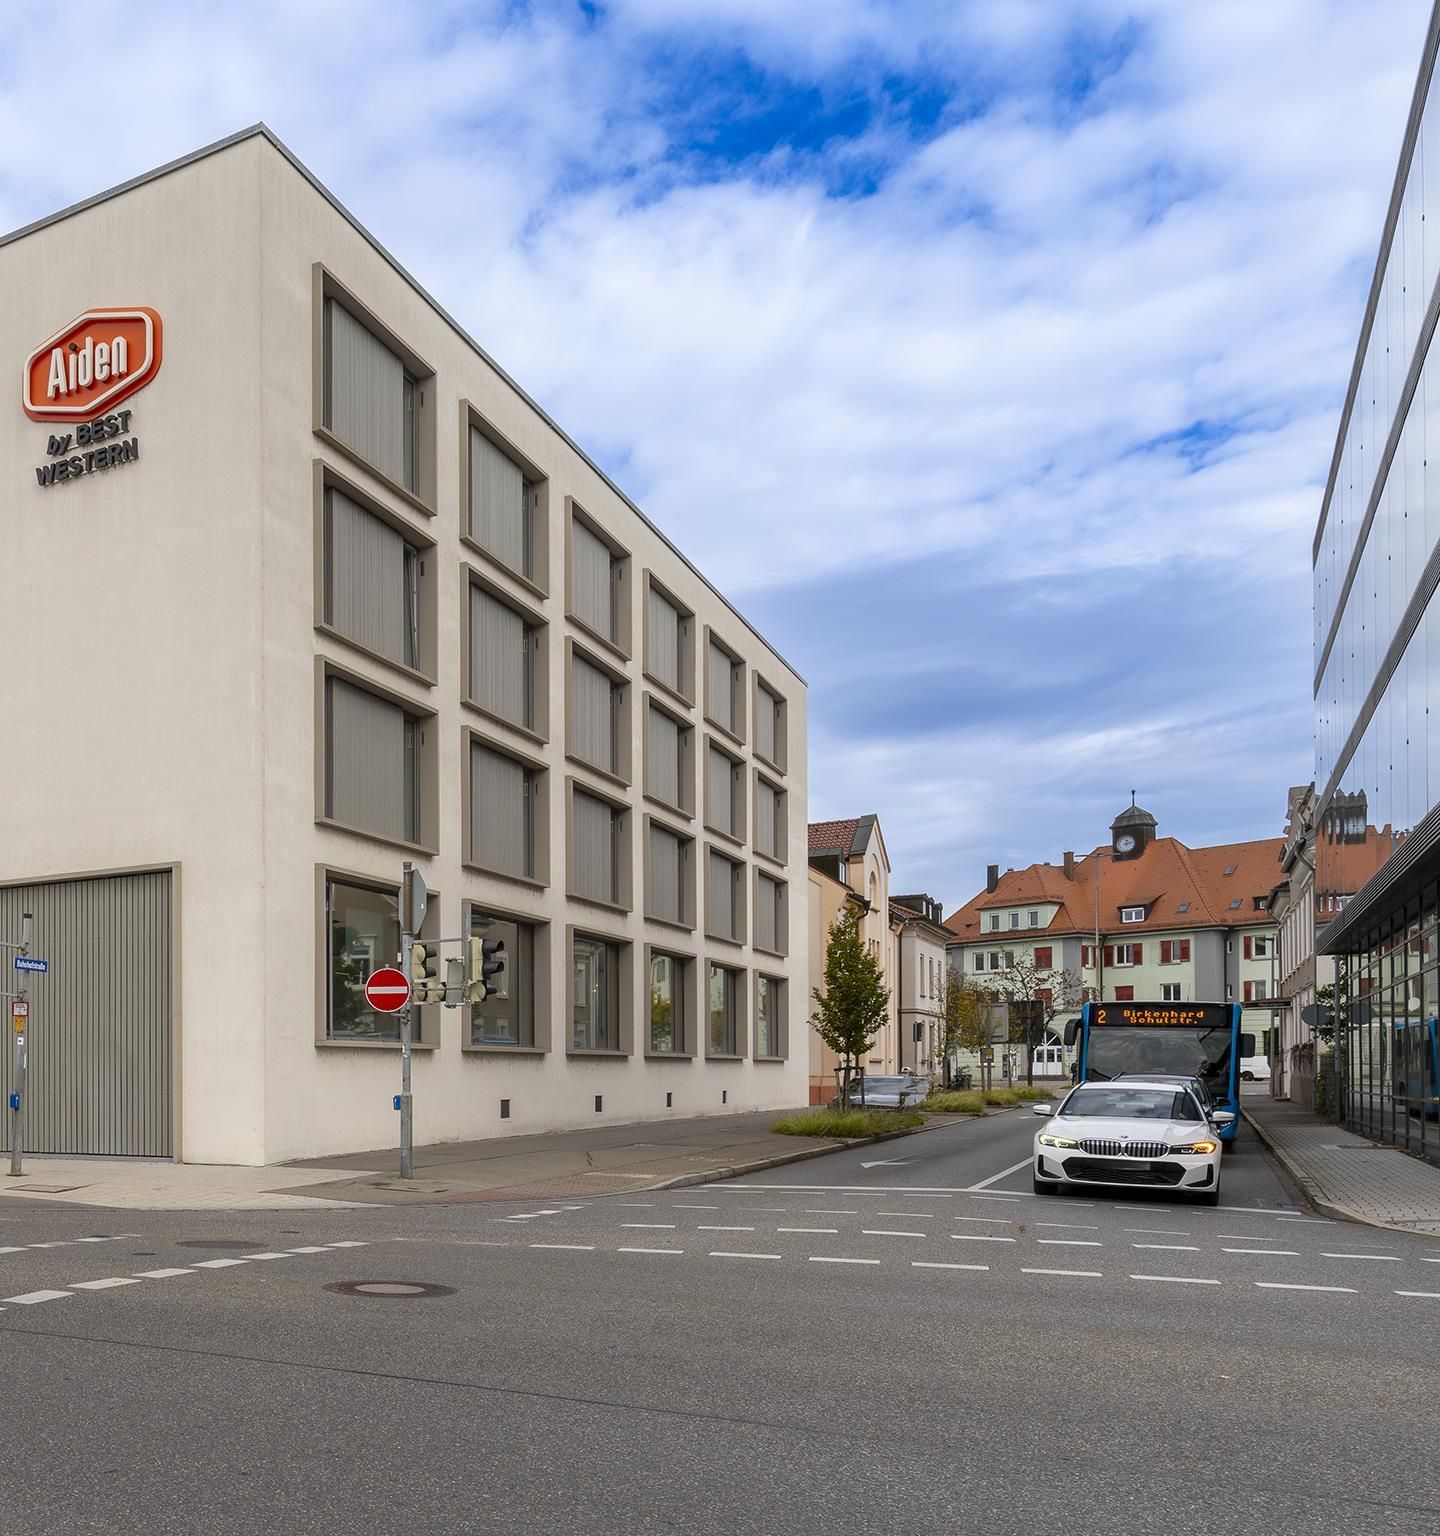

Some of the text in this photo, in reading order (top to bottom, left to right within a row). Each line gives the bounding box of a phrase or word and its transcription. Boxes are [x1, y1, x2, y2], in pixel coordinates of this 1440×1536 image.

[46, 335, 128, 399] Aiden
[46, 409, 132, 456] by BEST
[35, 437, 140, 488] WESTERN
[1097, 1009, 1205, 1024] 2 Birkenhard
